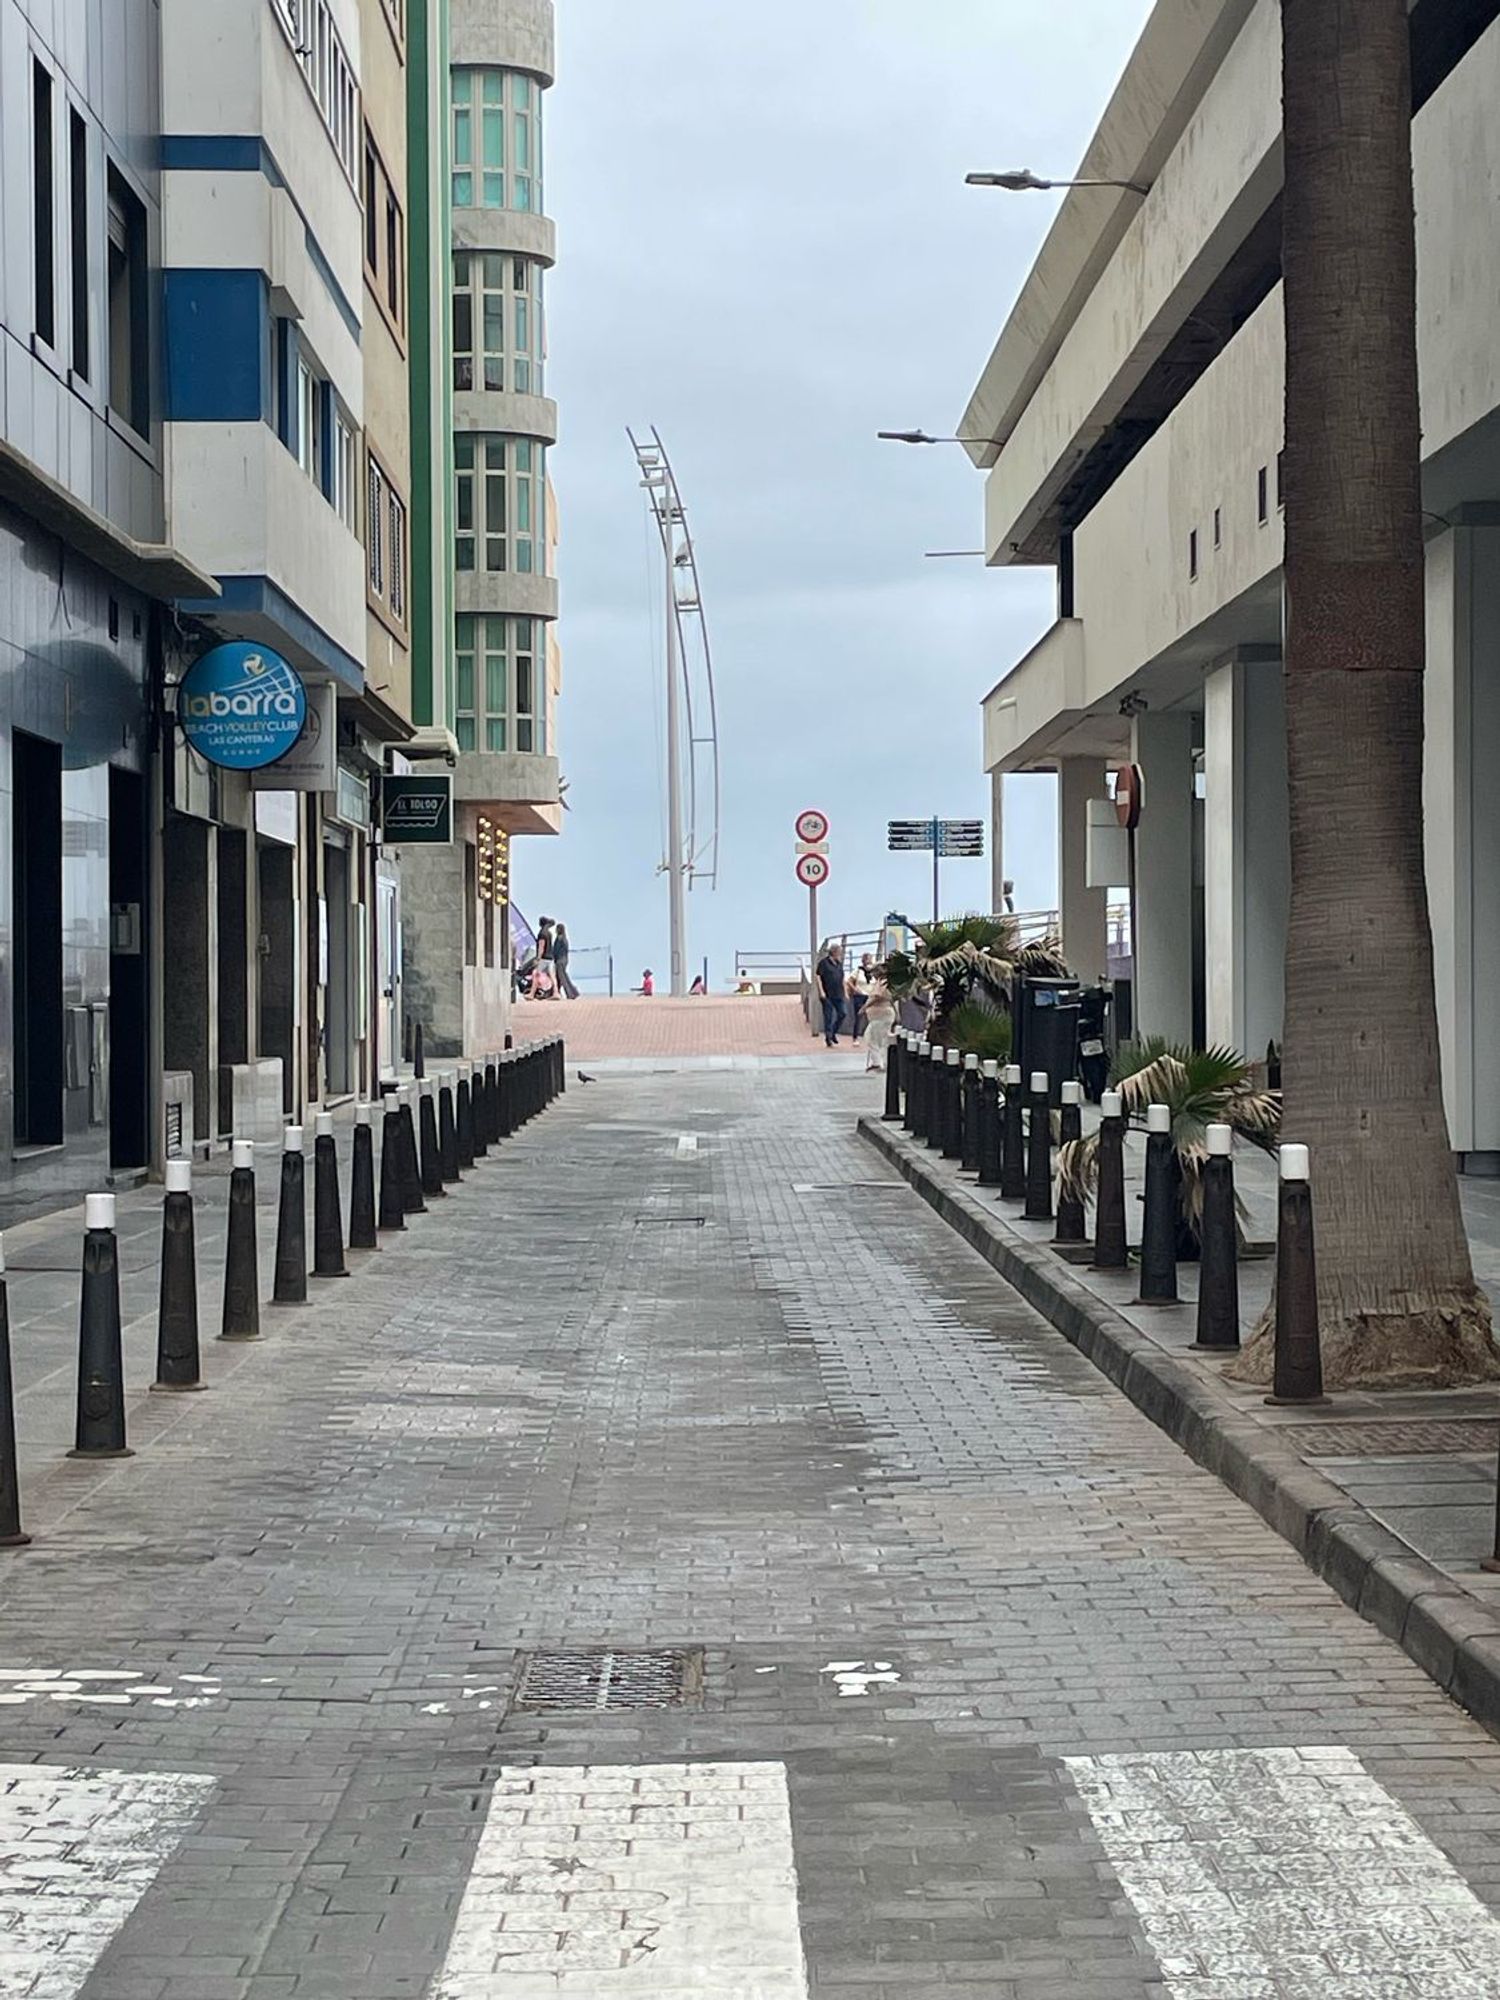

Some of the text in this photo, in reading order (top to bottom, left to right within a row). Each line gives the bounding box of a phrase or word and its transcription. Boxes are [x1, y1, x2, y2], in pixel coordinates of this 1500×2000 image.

[208, 733, 275, 746] LAS CANTERAS
[806, 864, 821, 875] 10
